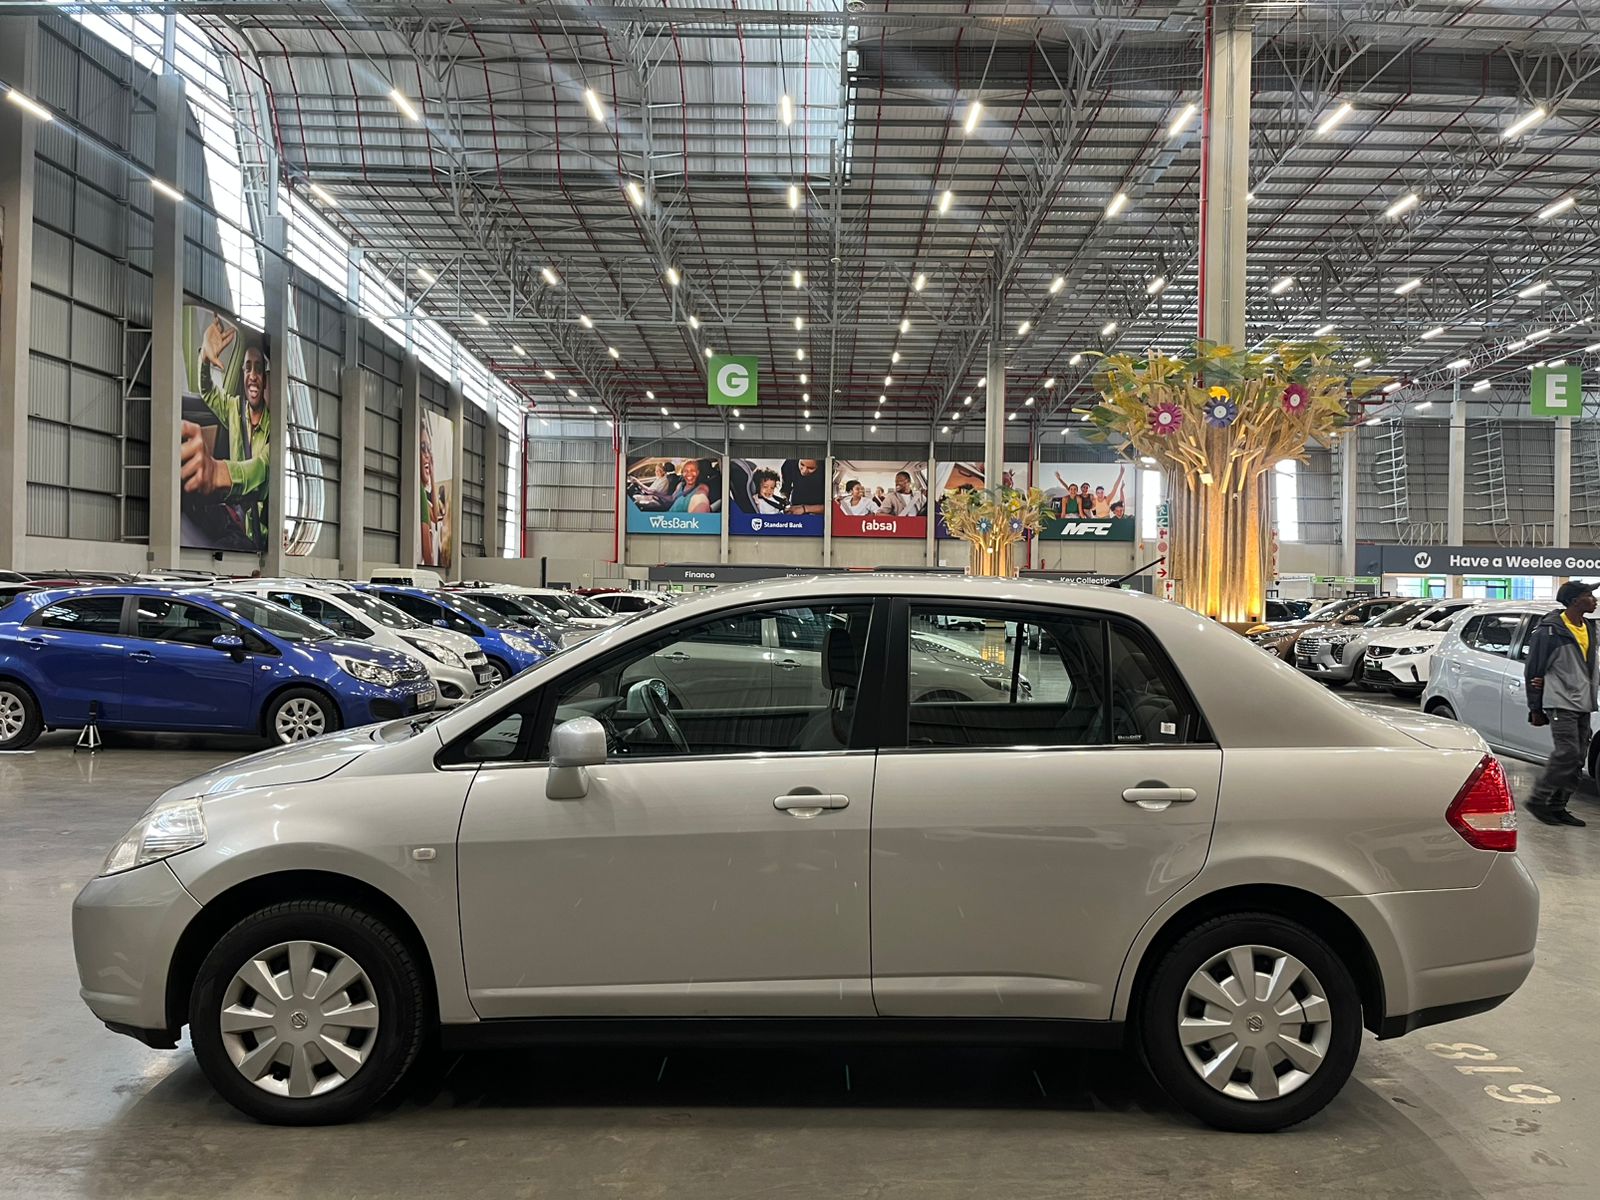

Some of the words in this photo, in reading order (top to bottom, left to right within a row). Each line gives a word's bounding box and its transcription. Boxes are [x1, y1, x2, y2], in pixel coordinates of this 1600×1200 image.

[717, 363, 749, 397] G
[1545, 374, 1568, 408] E
[649, 515, 699, 529] WesBank
[1061, 522, 1111, 536] MFC
[1450, 554, 1490, 568] Have
[1493, 557, 1503, 568] a
[1506, 555, 1562, 569] Weelee
[684, 570, 716, 579] Finance
